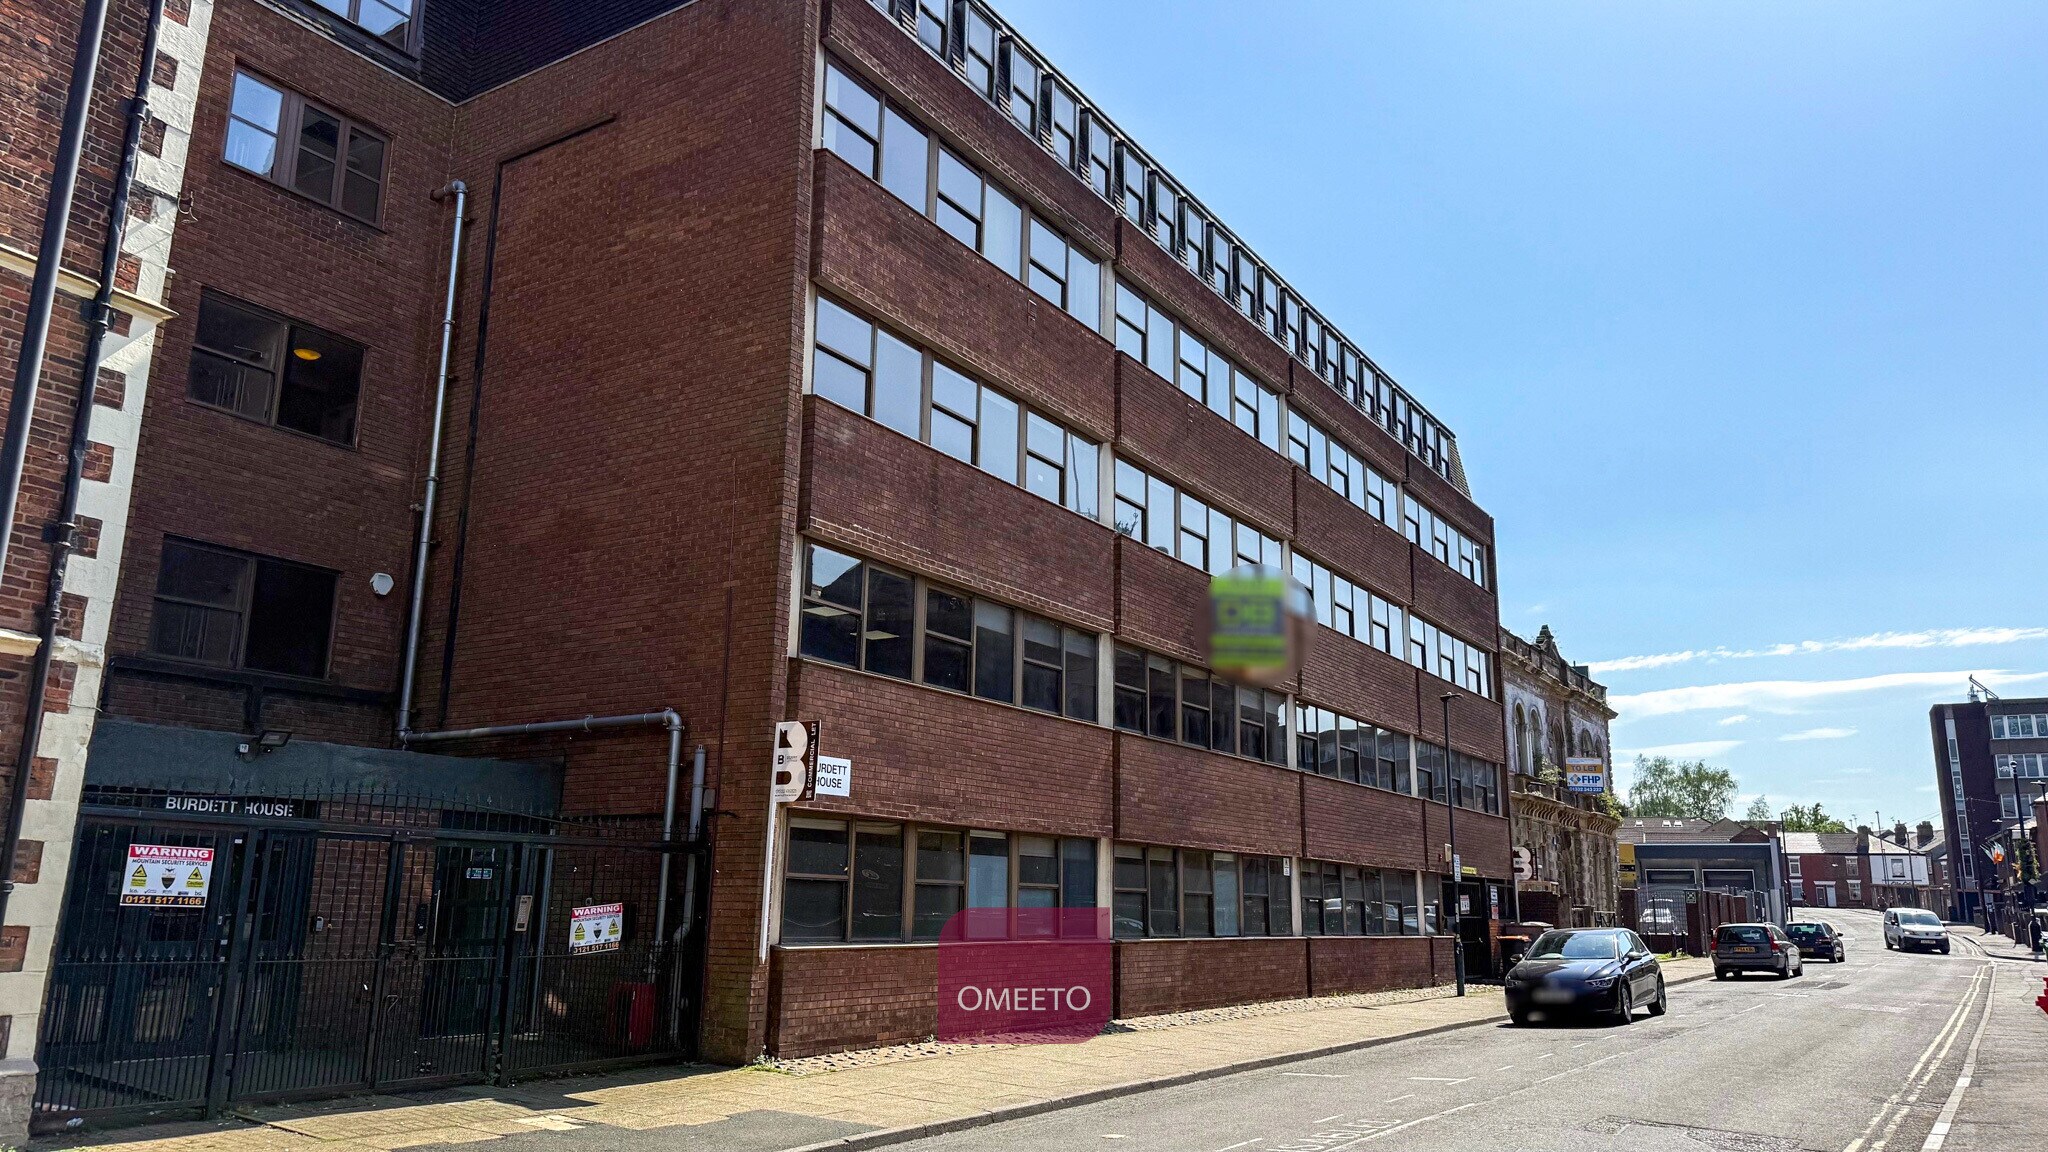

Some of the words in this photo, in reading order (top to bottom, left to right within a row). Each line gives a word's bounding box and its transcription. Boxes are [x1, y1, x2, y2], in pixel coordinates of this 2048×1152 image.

[807, 739, 815, 787] COMMERCIAL
[165, 796, 239, 814] BURDETT
[244, 802, 294, 817] HOUSE
[134, 846, 209, 858] WARNING
[125, 895, 151, 904] 0121
[155, 896, 175, 904] 517
[177, 896, 202, 905] 1166
[574, 906, 619, 915] WARNING
